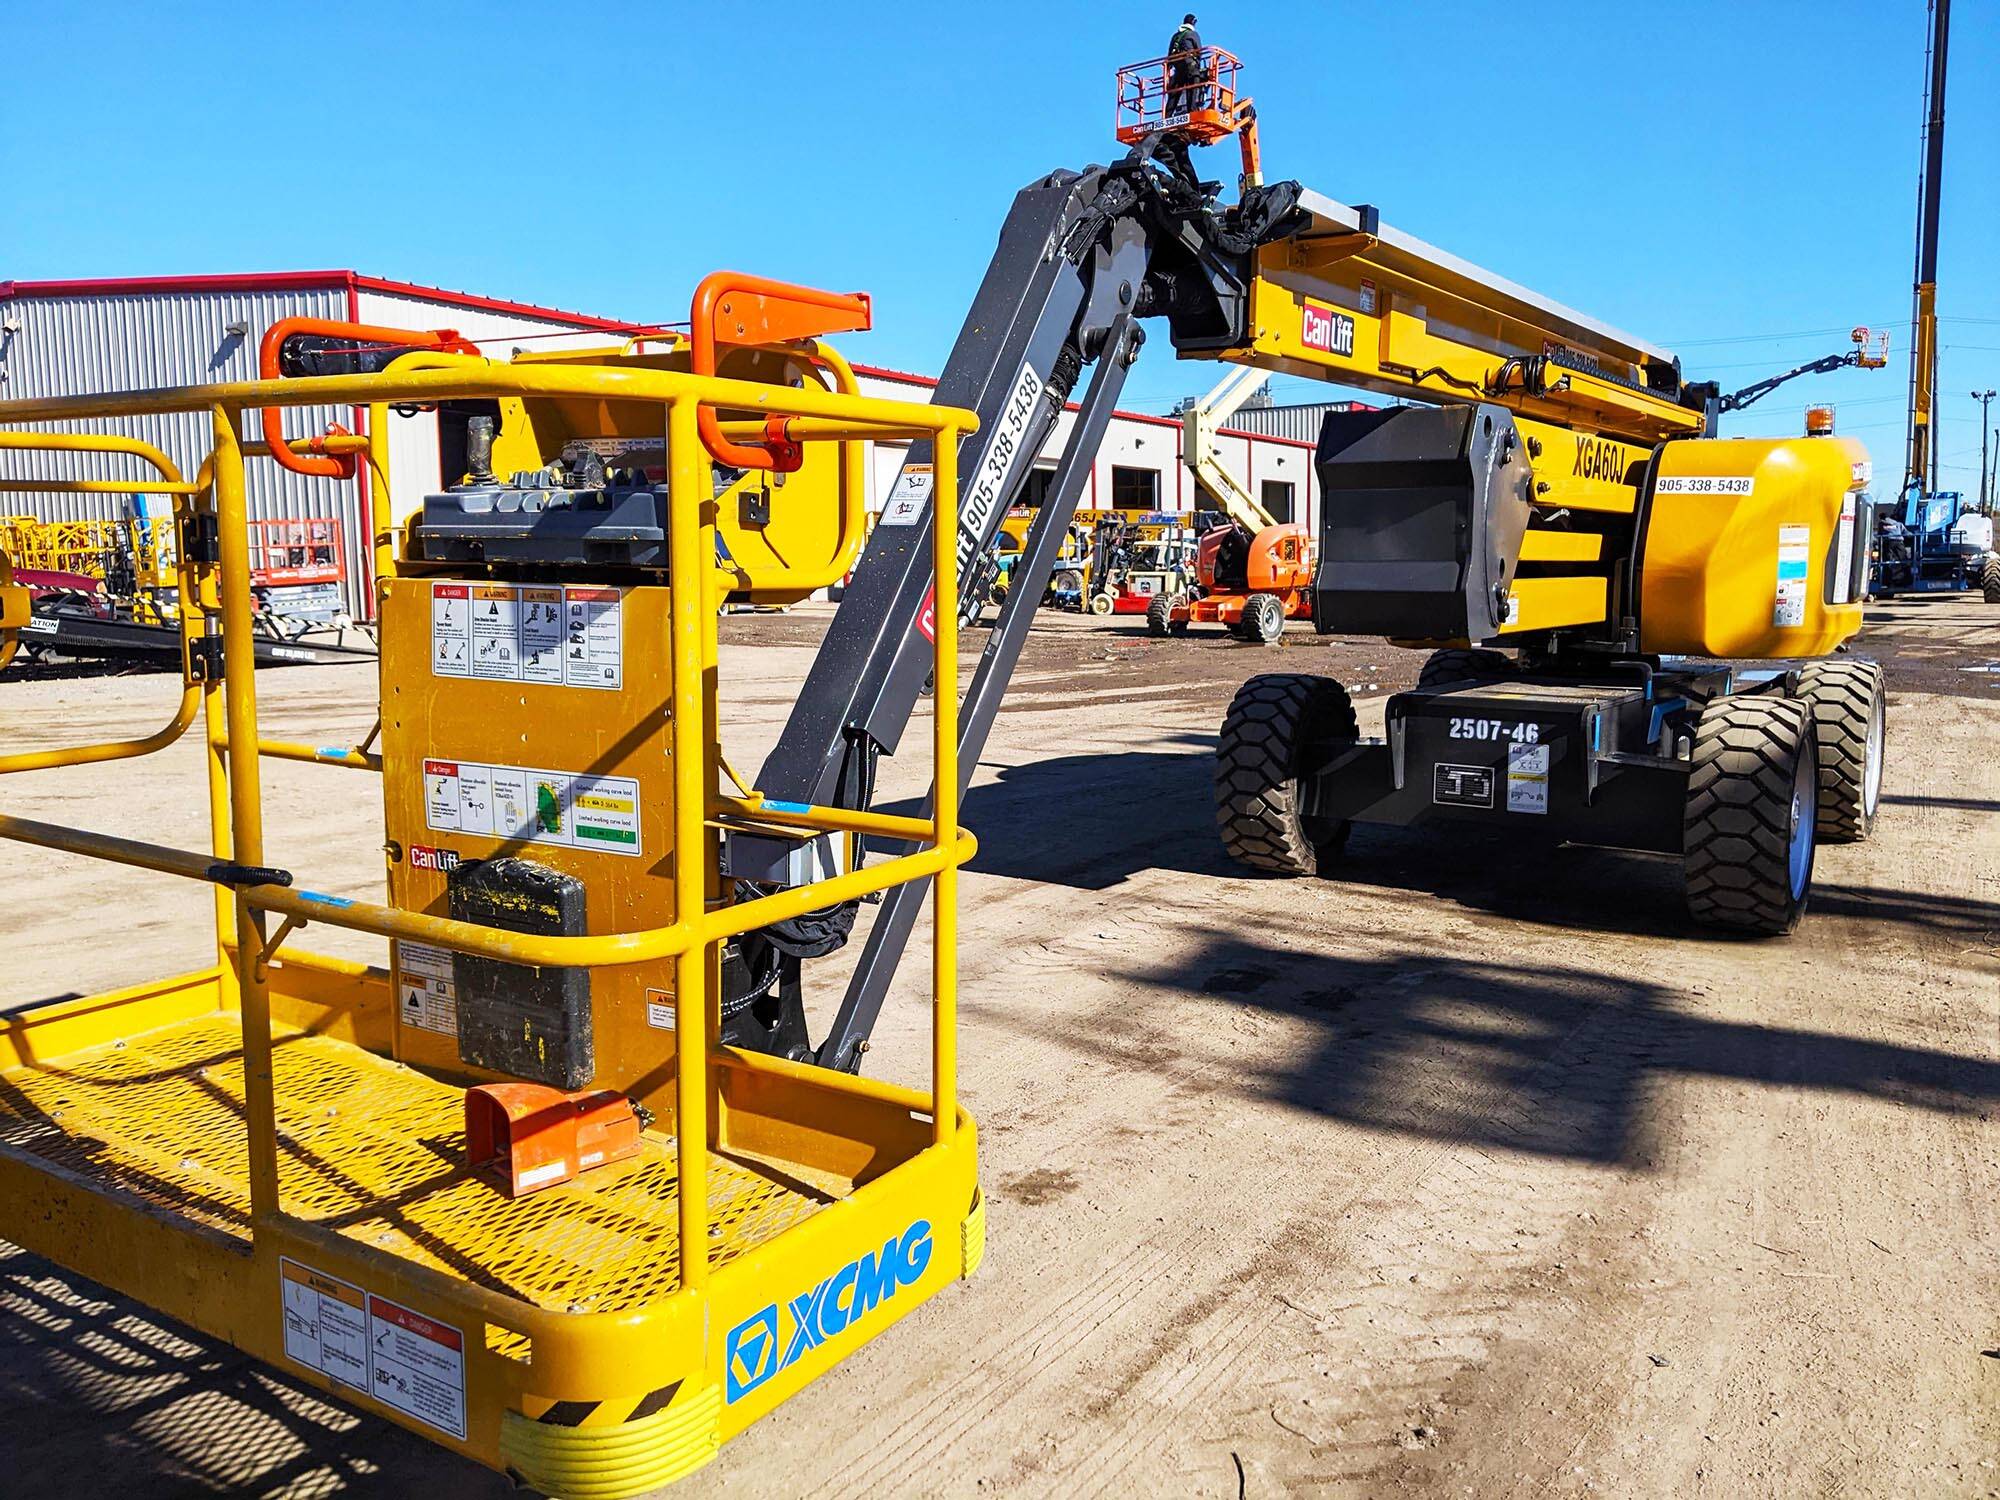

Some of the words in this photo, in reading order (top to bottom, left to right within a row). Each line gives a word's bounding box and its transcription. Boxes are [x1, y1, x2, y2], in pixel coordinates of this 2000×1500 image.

[1303, 309, 1353, 354] CanLift
[966, 372, 1039, 532] 905-338-5438
[1572, 436, 1626, 485] XGA60J
[1658, 479, 1750, 493] 905-338-5438
[1449, 717, 1540, 744] 2507-46
[411, 847, 459, 872] CanLift
[777, 1219, 933, 1373] XCMG
